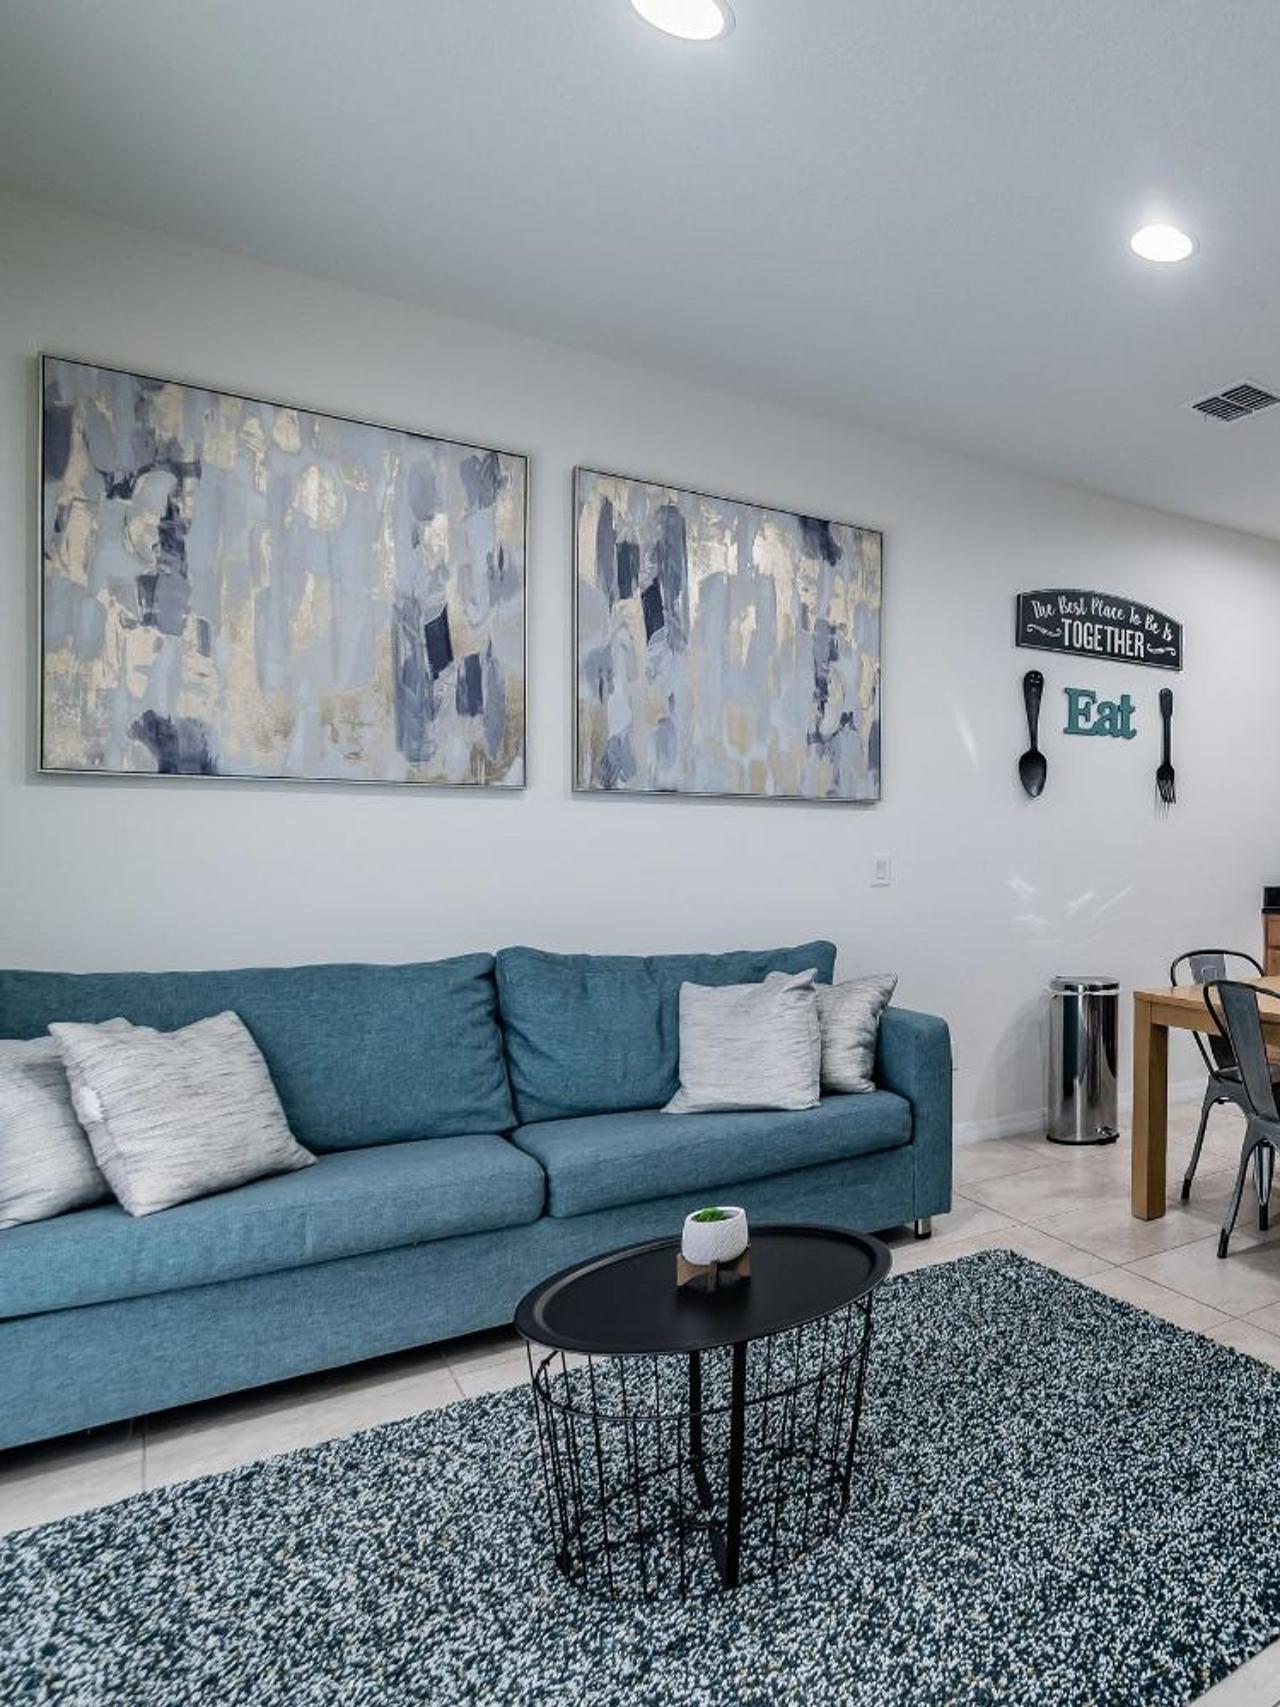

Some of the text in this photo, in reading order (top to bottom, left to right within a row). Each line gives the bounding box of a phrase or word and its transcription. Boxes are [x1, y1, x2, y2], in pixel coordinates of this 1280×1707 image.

[1032, 595, 1173, 641] The Best Place To Be Is
[1061, 617, 1145, 658] TOGETHER
[1063, 687, 1137, 740] Eat
